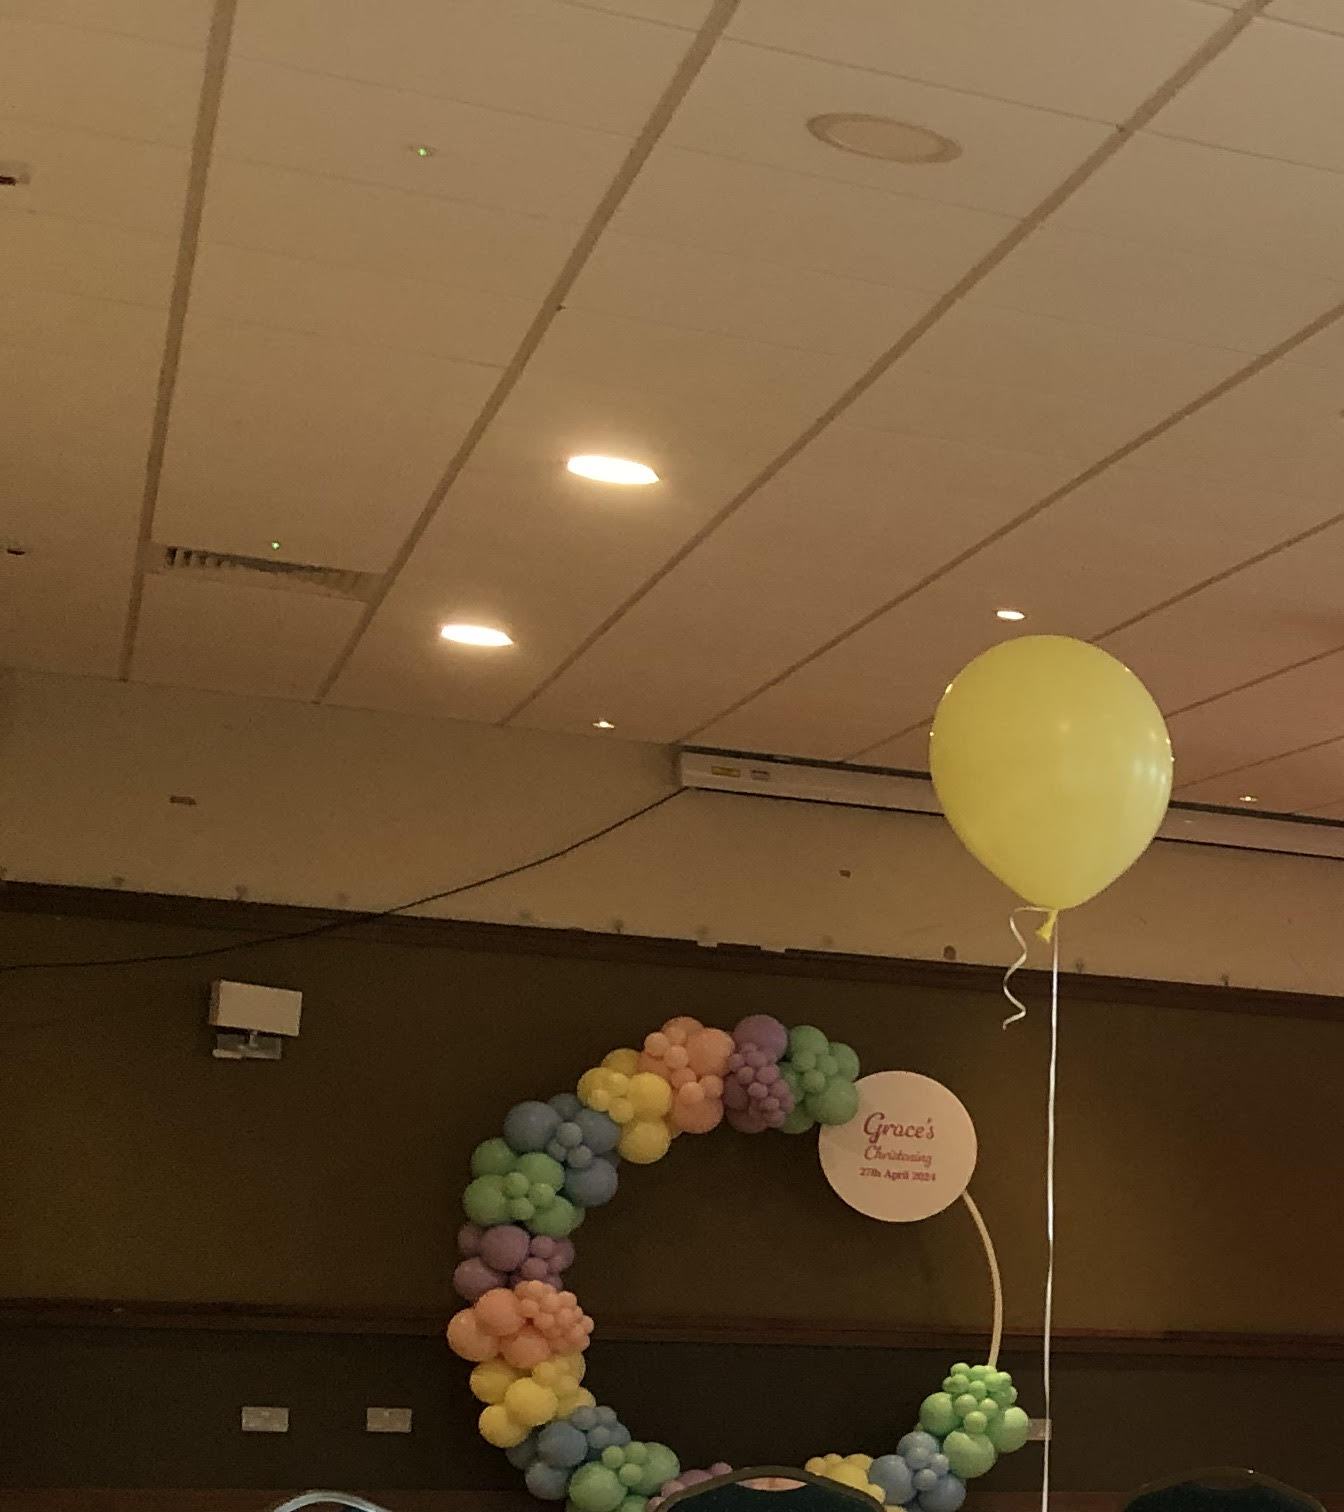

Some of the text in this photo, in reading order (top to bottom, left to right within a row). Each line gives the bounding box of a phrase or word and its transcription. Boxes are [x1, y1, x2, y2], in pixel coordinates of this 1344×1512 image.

[863, 1112, 935, 1144] Grace's
[864, 1145, 932, 1167] Christening
[859, 1167, 881, 1177] 27th
[884, 1169, 909, 1181] April
